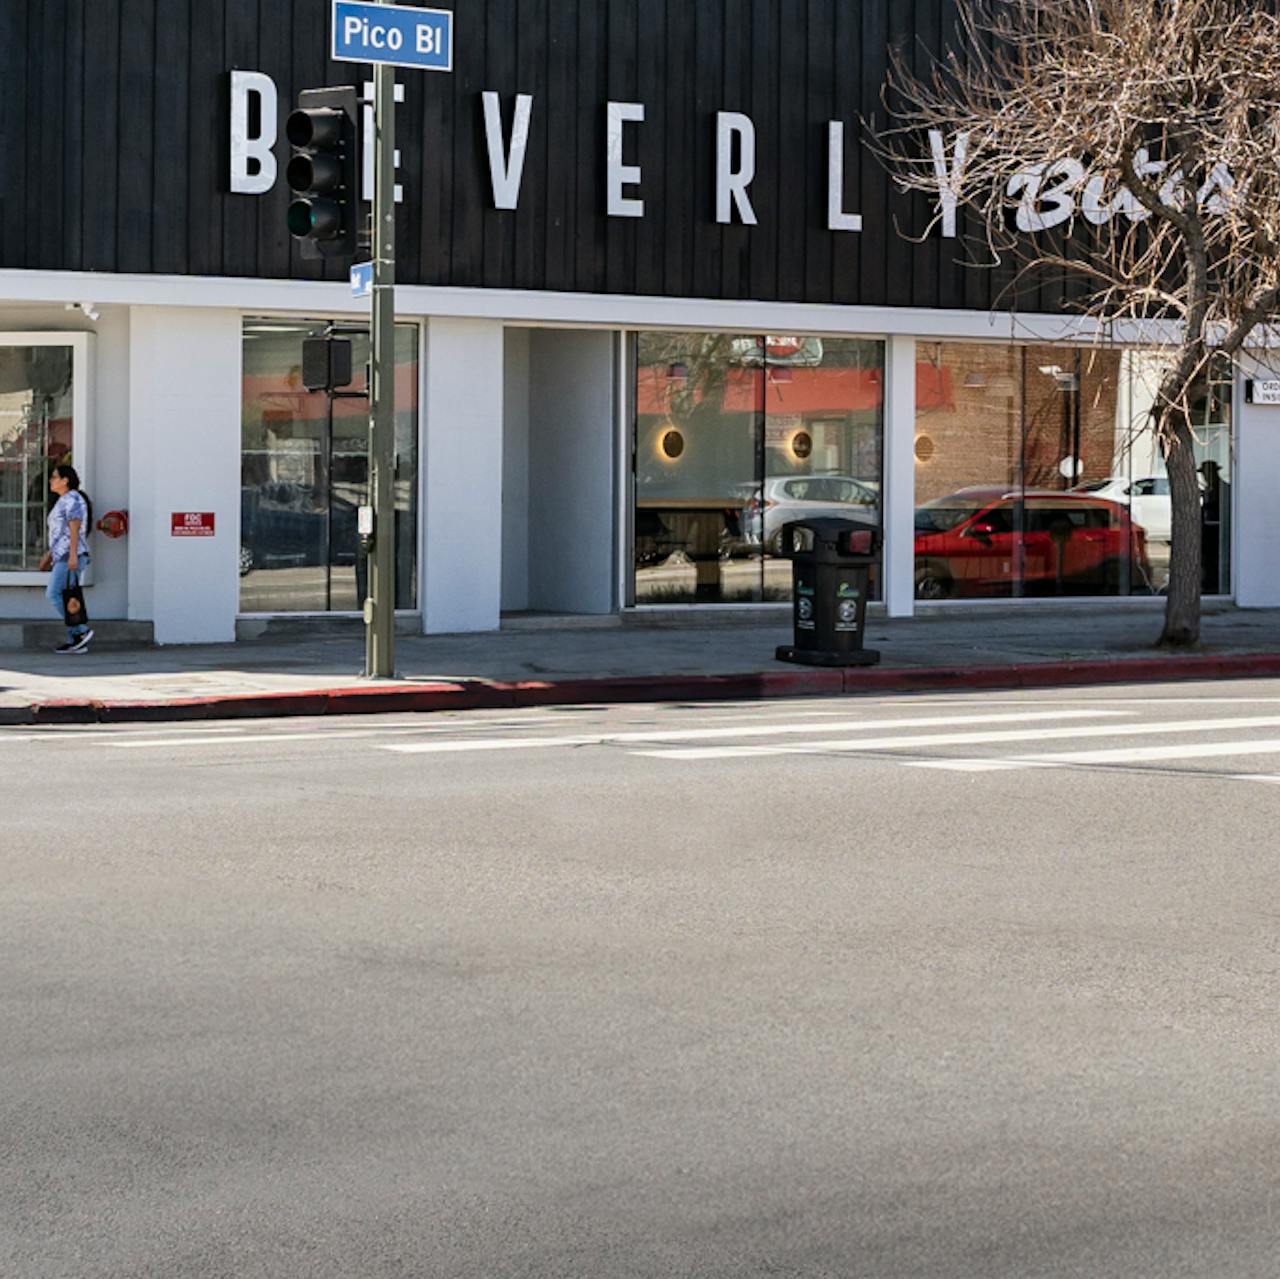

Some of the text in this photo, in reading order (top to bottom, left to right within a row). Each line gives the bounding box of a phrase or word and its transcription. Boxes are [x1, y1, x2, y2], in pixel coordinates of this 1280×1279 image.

[344, 16, 442, 55] Pico Bl
[229, 70, 970, 239] BEVERLY
